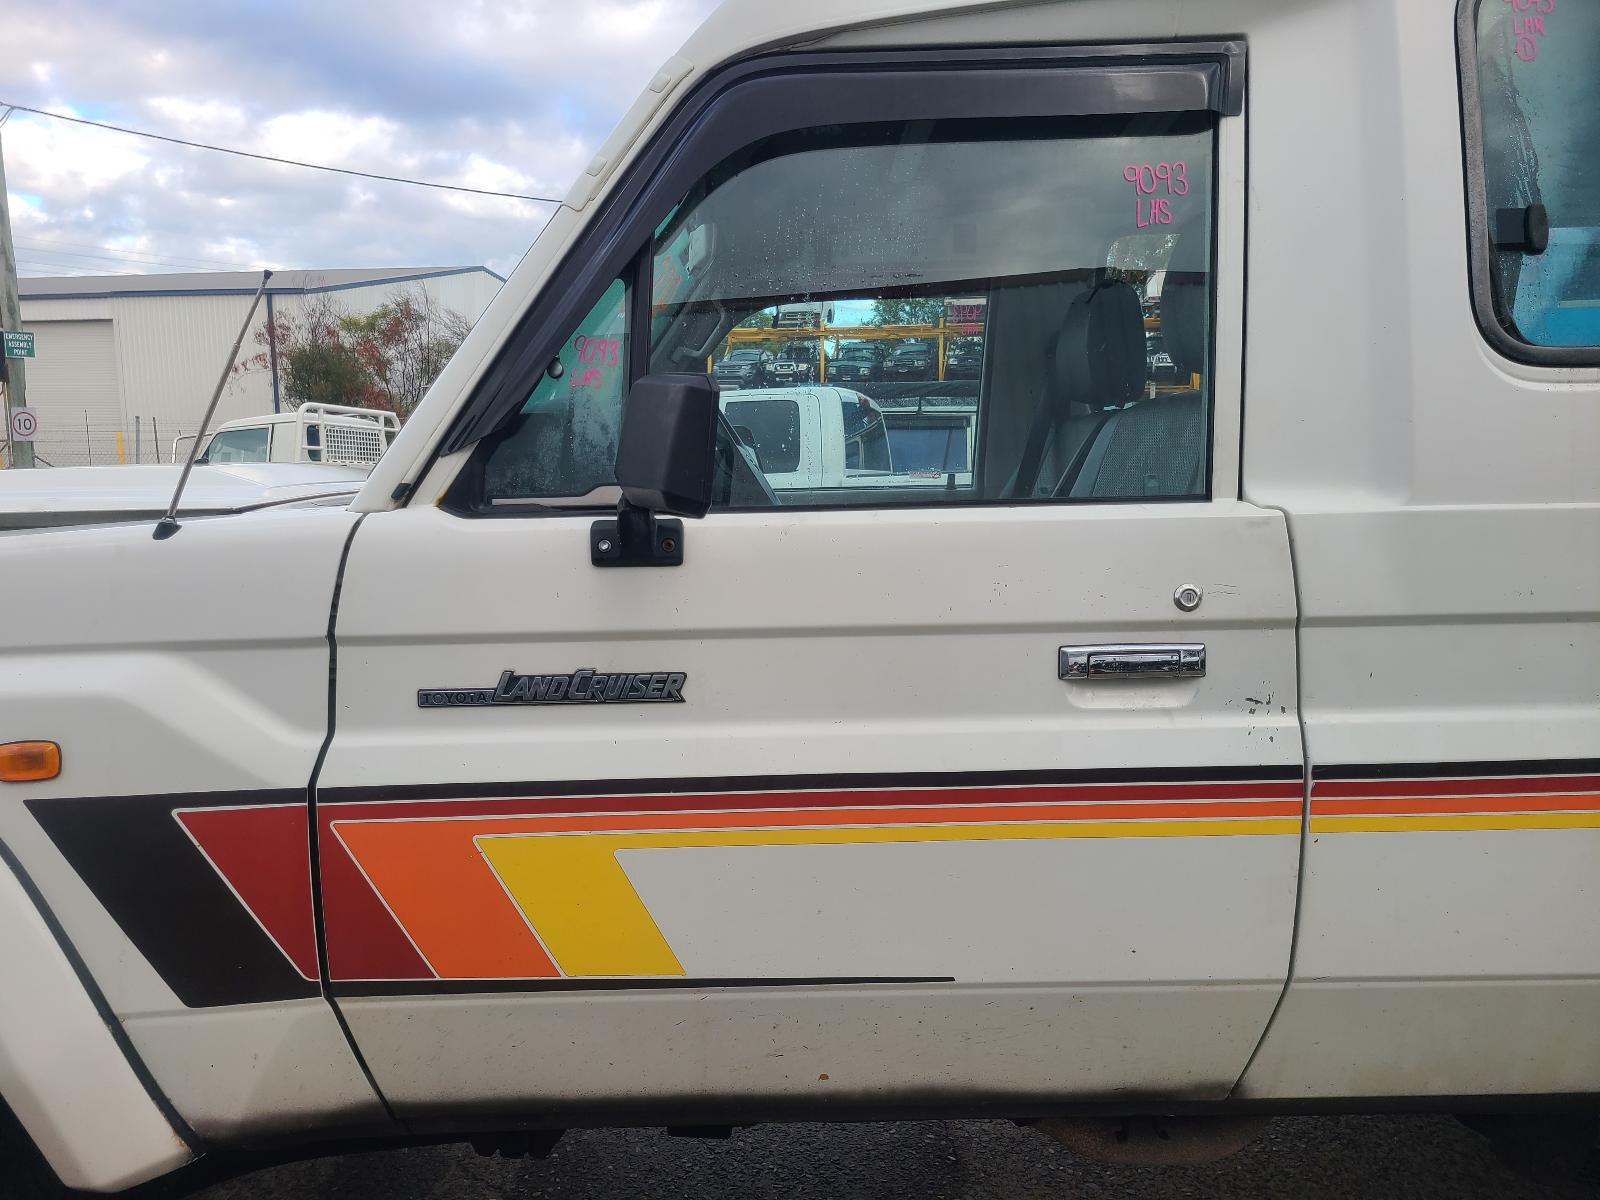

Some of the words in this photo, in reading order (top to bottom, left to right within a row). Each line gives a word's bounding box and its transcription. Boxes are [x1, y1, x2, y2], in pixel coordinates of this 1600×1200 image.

[1513, 15, 1547, 37] LHR
[1123, 160, 1189, 196] 9093
[1136, 198, 1172, 228] LHS
[5, 333, 33, 341] EMERGENCY
[8, 340, 32, 349] ASSEMBLY
[574, 335, 619, 368] 9093
[13, 348, 28, 356] POINT
[18, 418, 32, 431] 10
[422, 691, 488, 705] TOYOTA
